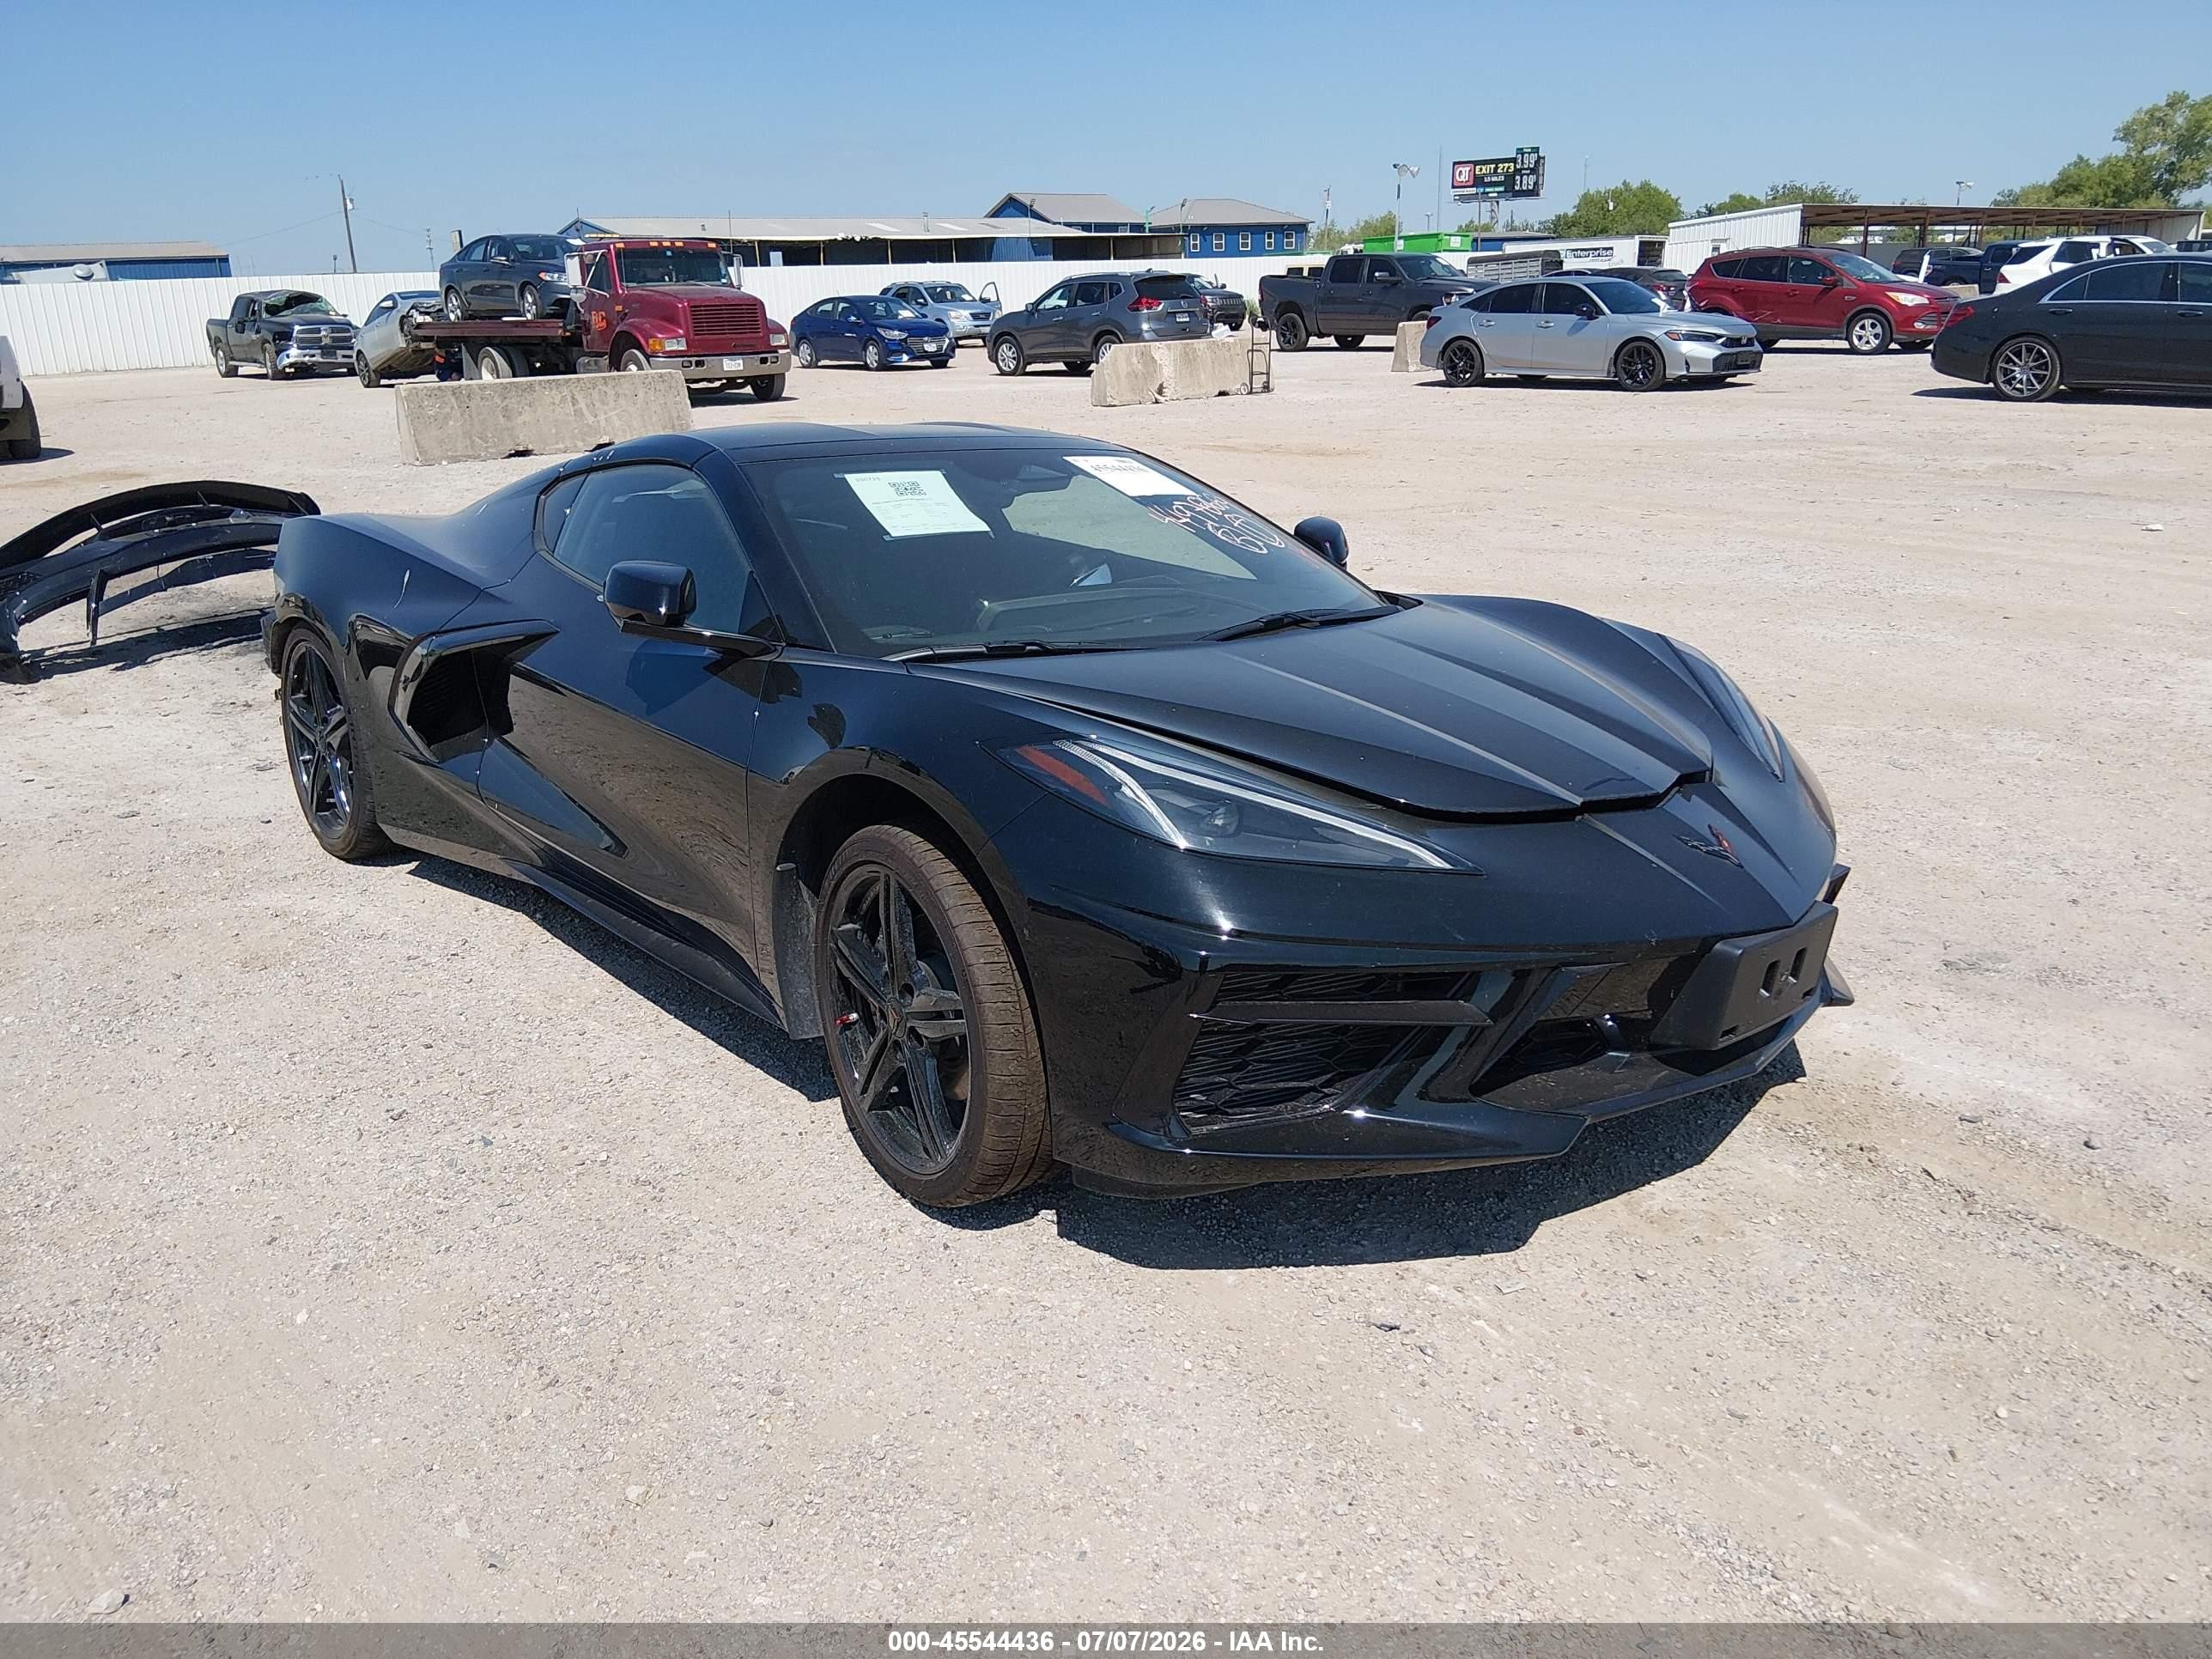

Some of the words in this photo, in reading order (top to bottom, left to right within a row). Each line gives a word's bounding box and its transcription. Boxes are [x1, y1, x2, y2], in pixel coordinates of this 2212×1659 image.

[1475, 164, 1496, 174] EXIT
[1497, 162, 1515, 173] 273
[1455, 167, 1471, 183] QT
[1565, 247, 1613, 259] Enterprise
